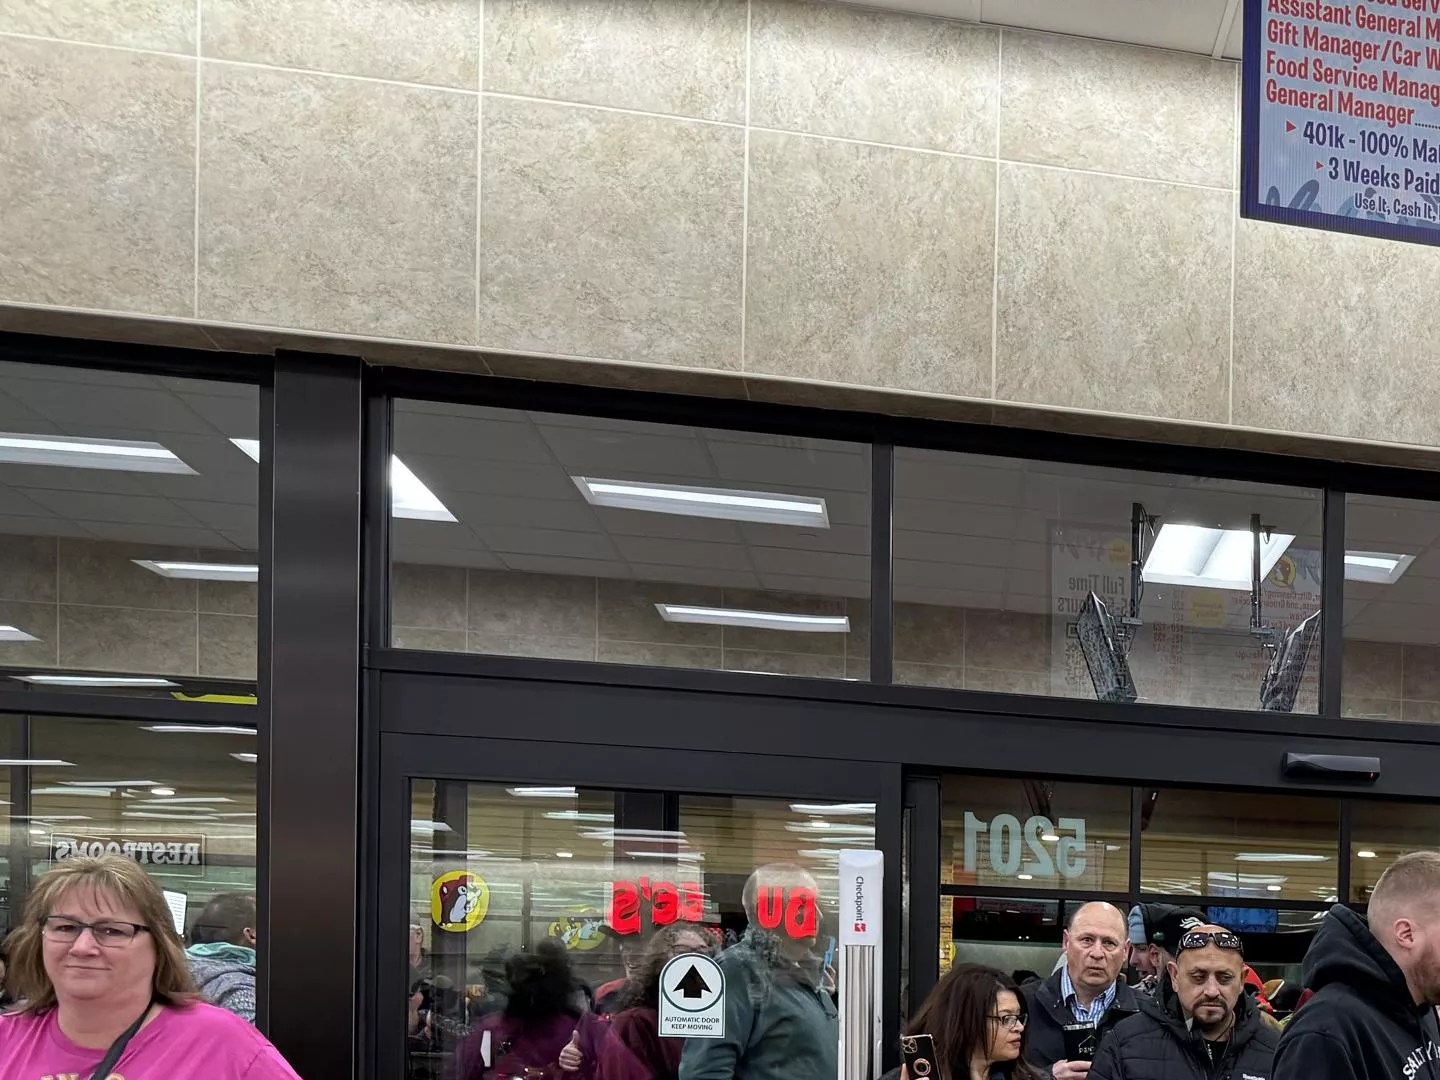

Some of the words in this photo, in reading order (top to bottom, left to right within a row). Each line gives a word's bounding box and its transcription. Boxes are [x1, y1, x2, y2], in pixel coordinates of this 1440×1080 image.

[1267, 0, 1351, 26] Assistant
[1355, 5, 1421, 37] General
[1267, 19, 1299, 47] Gift
[1303, 25, 1422, 67] Manager/Car
[1266, 50, 1308, 80] Food
[1313, 60, 1378, 92] Service
[1266, 78, 1333, 113] General
[1338, 90, 1415, 128] Manager
[1303, 120, 1345, 149] 401k
[1360, 130, 1409, 159] 100%
[1328, 157, 1339, 180] 3
[1343, 158, 1400, 189] Weeks
[1404, 168, 1440, 195] Paid
[1354, 193, 1376, 212] Use
[1393, 199, 1422, 218] Cash
[854, 876, 864, 921] Checkpoint
